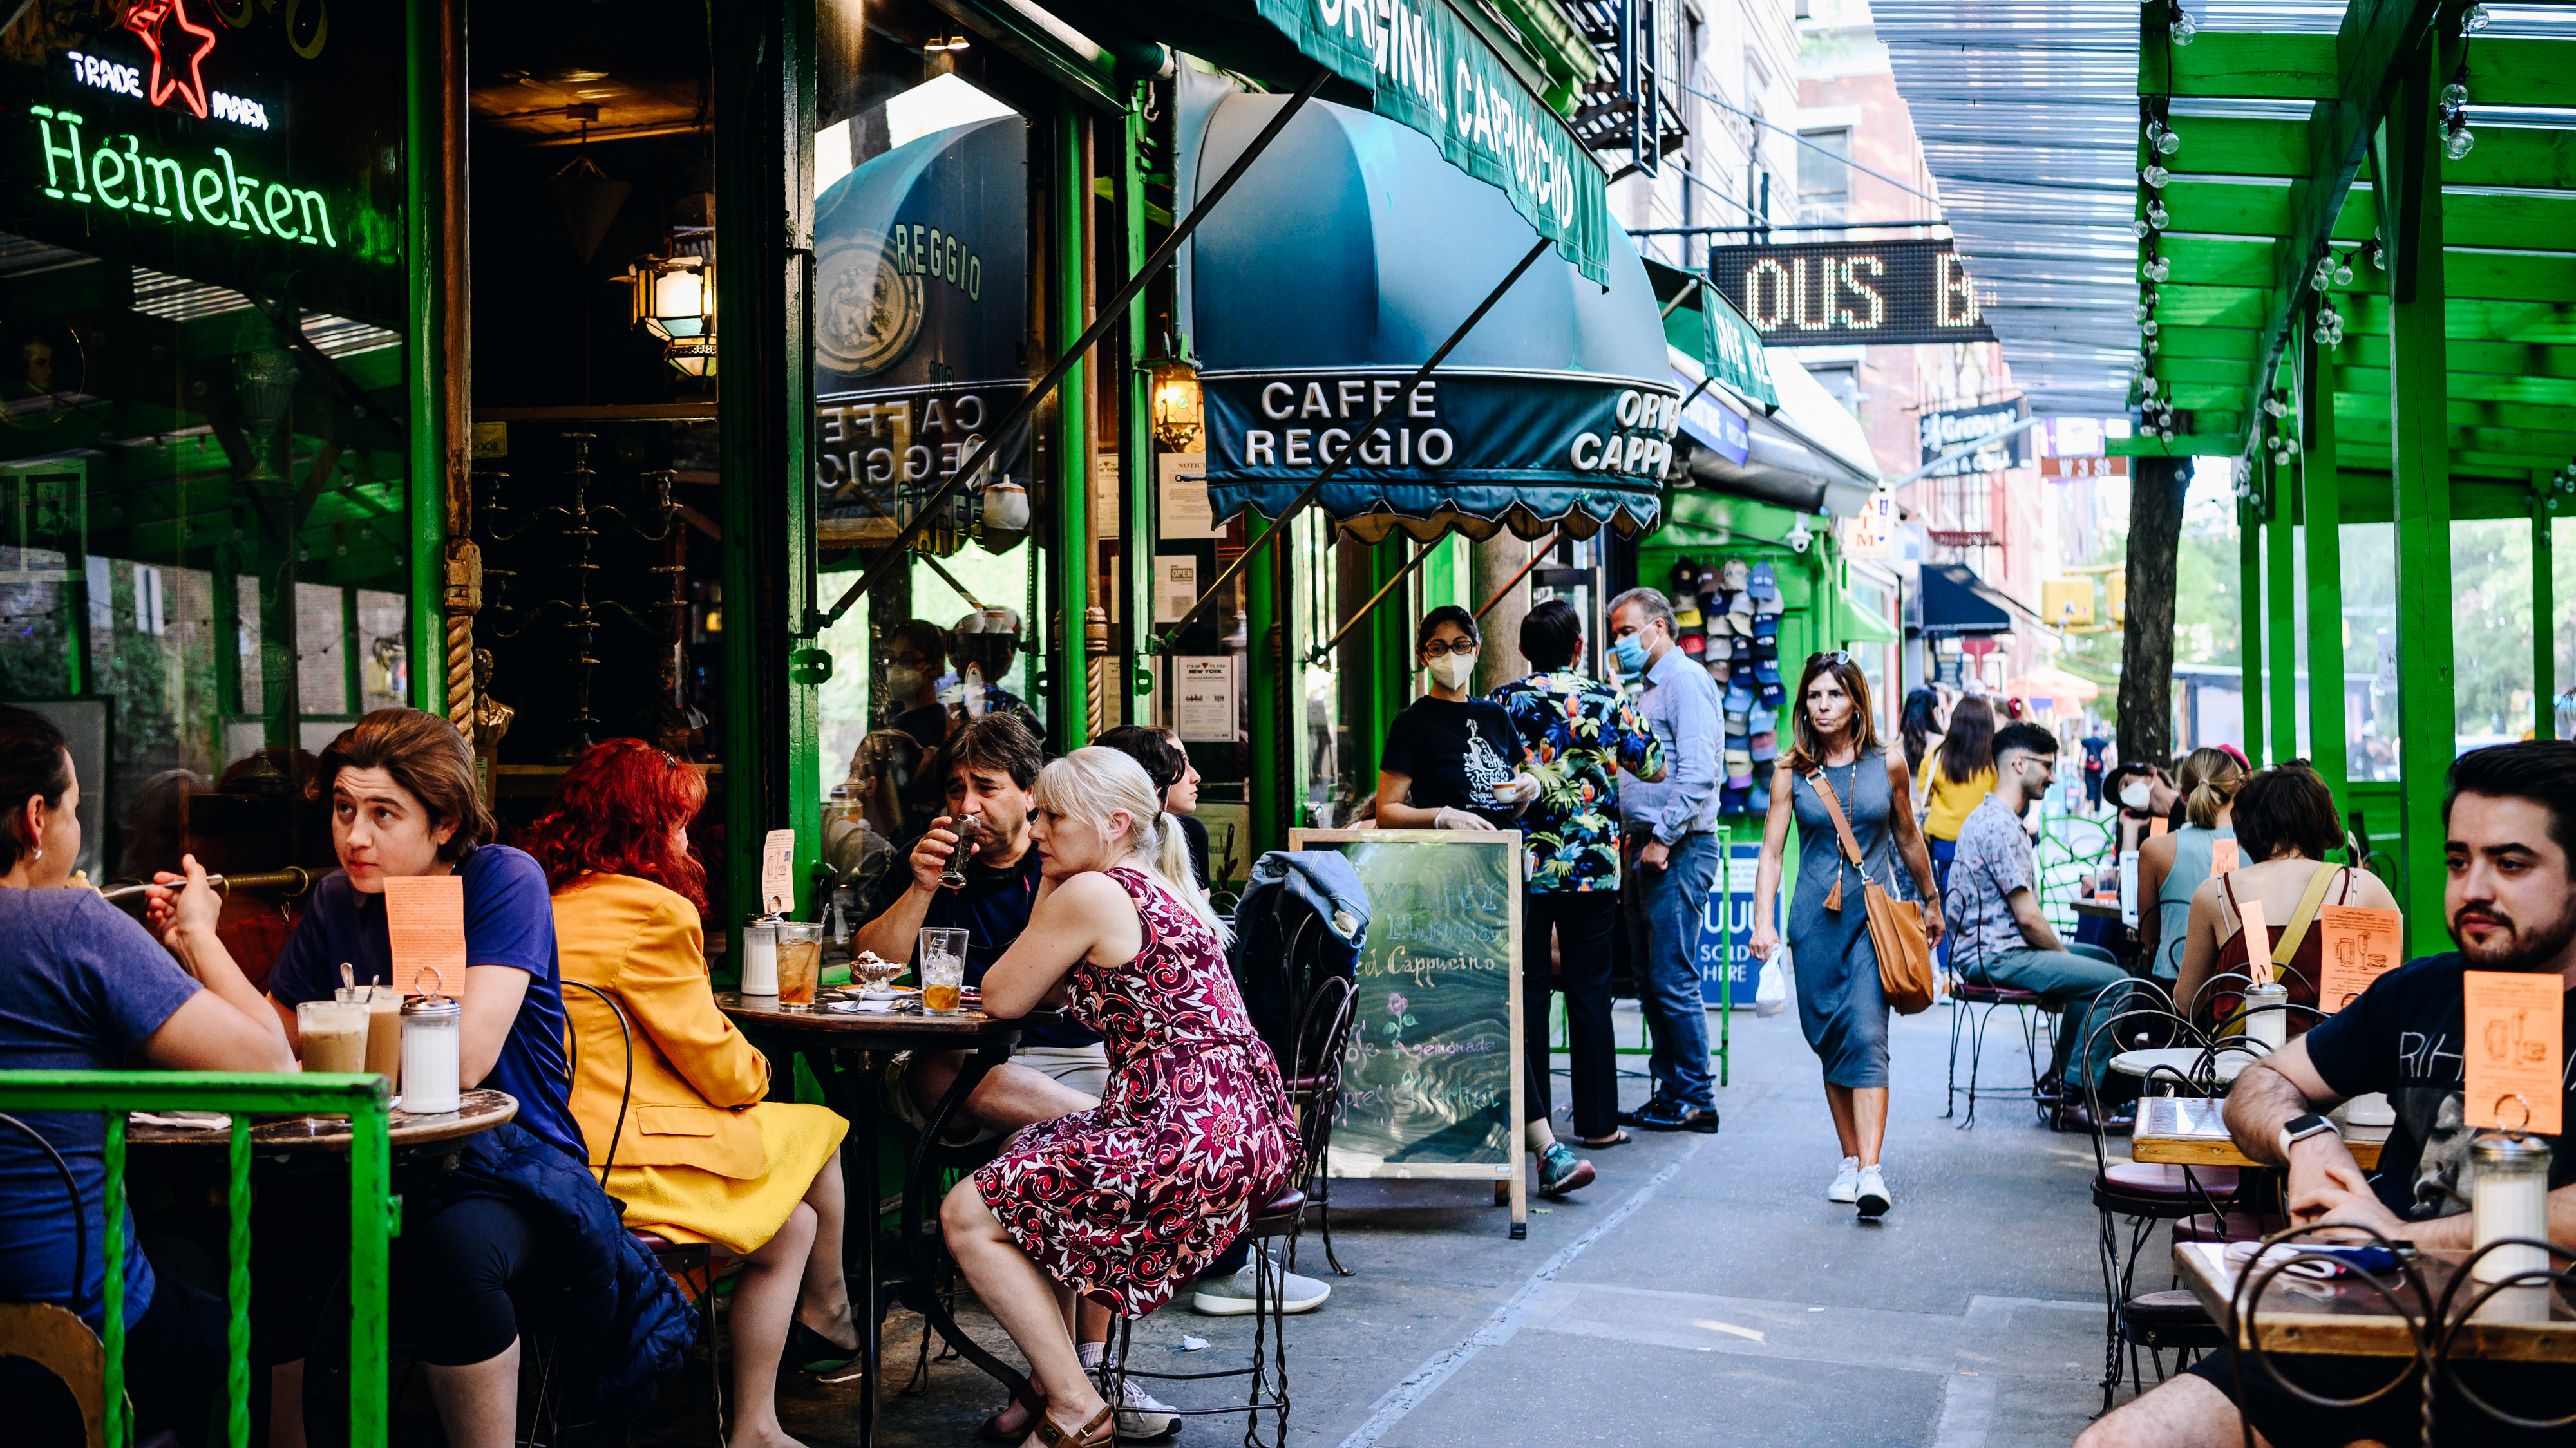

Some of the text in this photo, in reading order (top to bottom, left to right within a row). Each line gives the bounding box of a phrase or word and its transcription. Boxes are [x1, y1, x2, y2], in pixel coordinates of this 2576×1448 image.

[68, 50, 269, 131] TRADE MARK
[30, 104, 337, 249] Heineken
[895, 223, 981, 303] REGGIO
[1746, 254, 1884, 332] OUS
[1261, 379, 1436, 419] CAFFE
[1245, 427, 1454, 467] REGGIO
[2059, 457, 2112, 478] W 3 St
[1171, 569, 1193, 578] OPEN
[1387, 945, 1495, 988] Cappucino
[1700, 943, 1750, 963] SOLD
[2399, 1031, 2465, 1082] RIH
